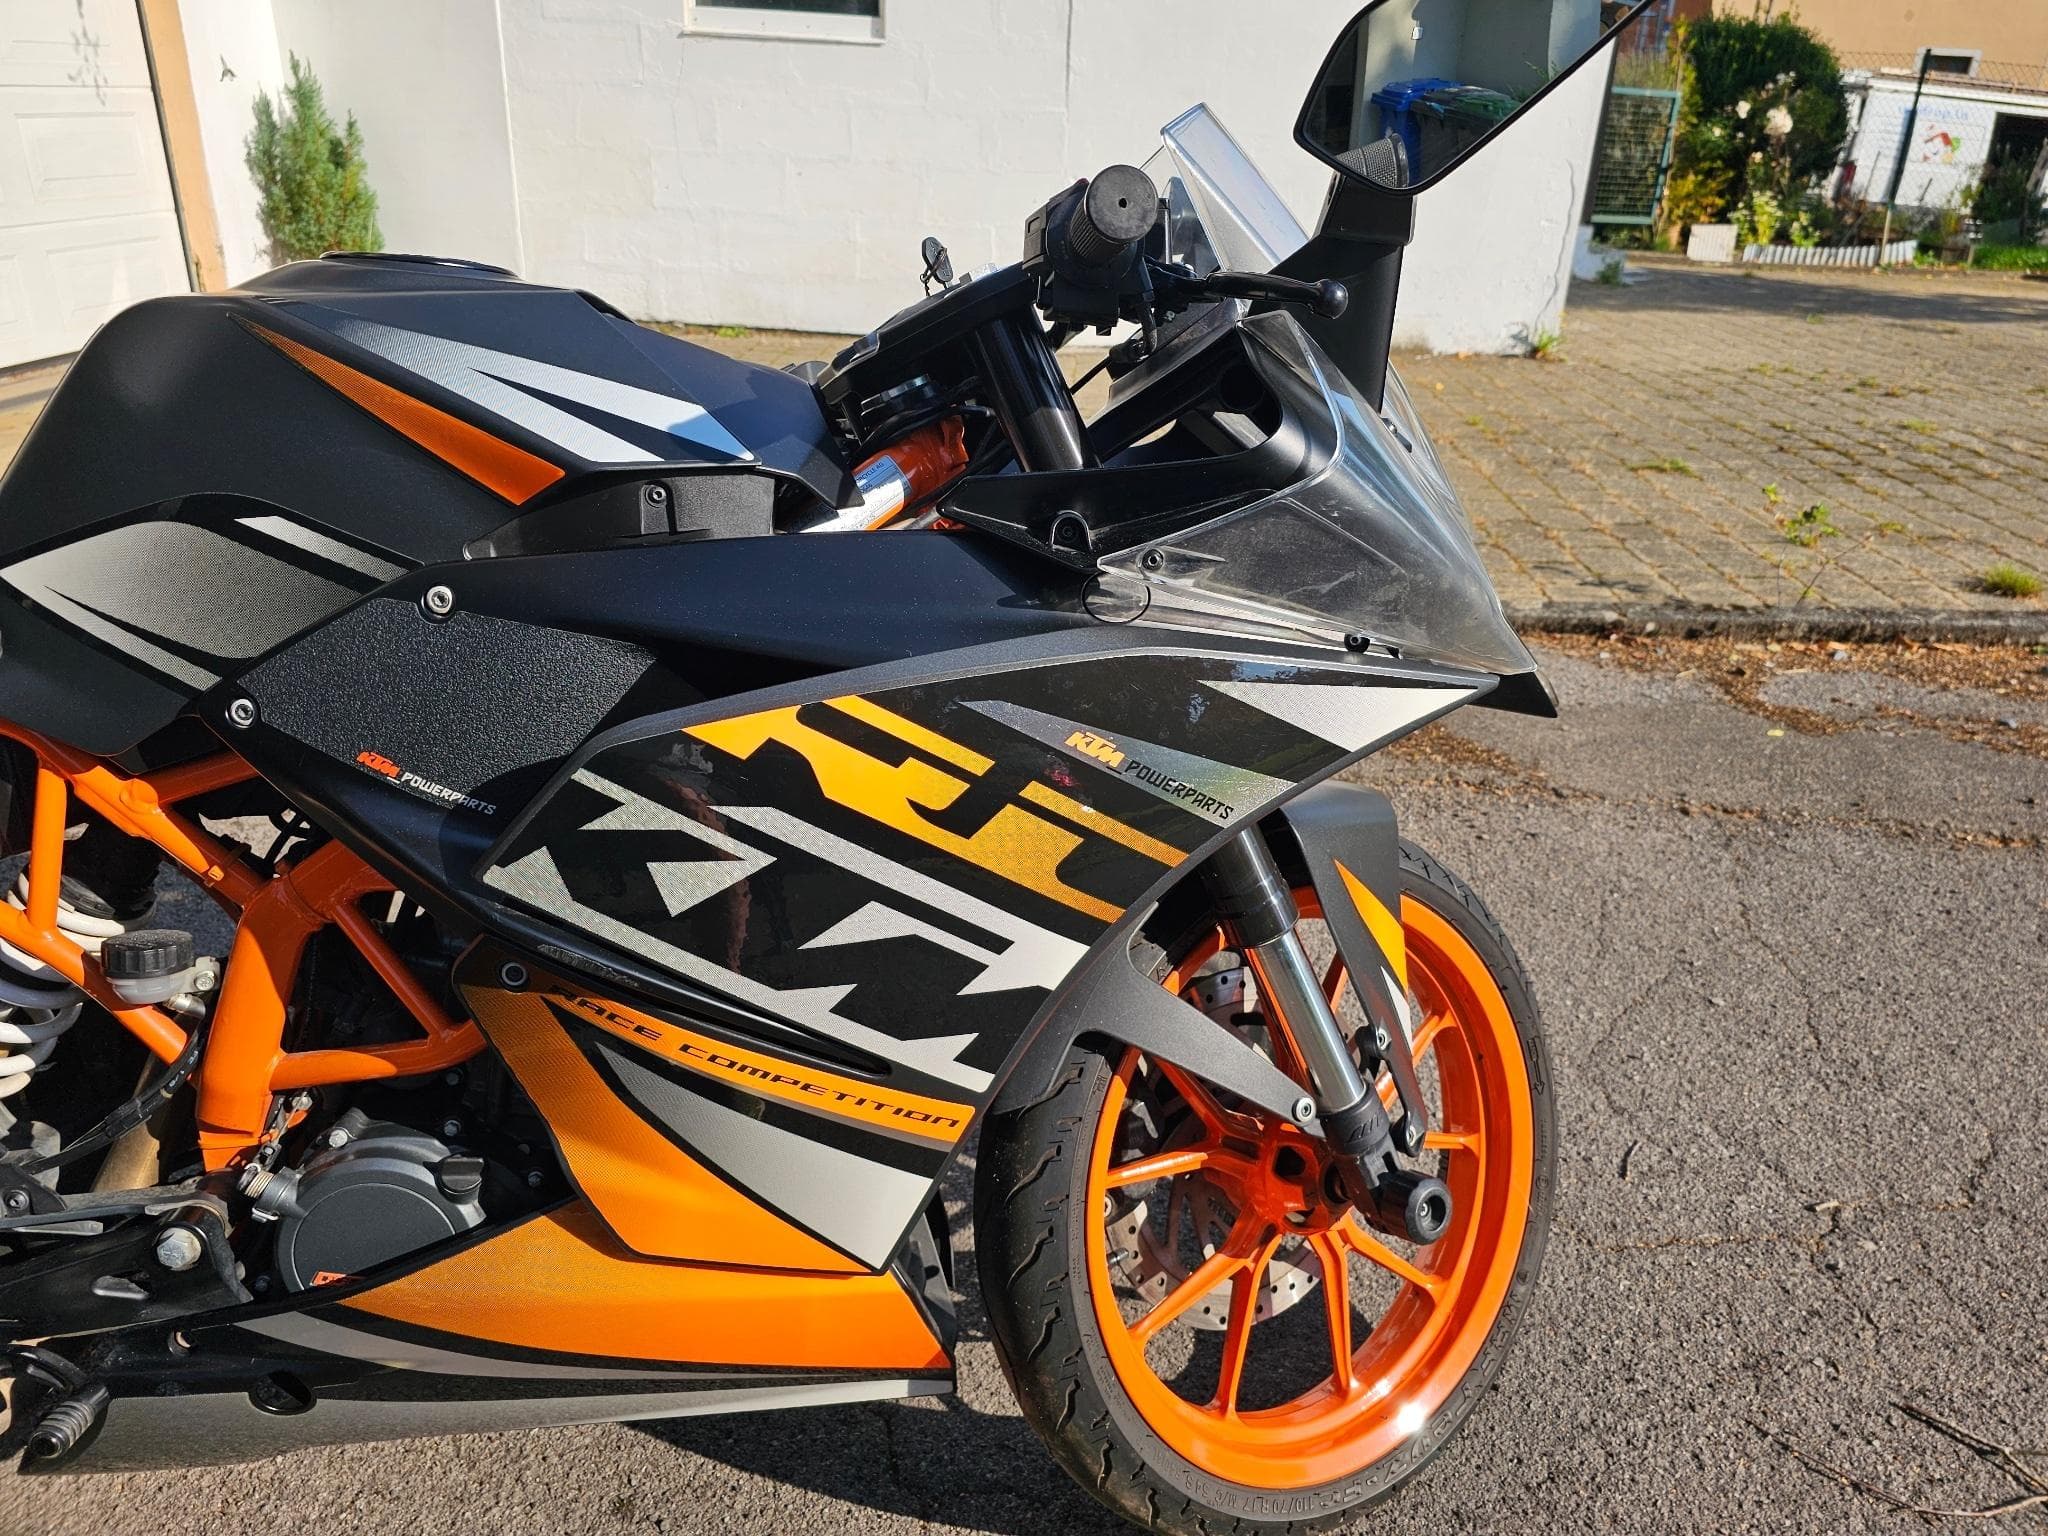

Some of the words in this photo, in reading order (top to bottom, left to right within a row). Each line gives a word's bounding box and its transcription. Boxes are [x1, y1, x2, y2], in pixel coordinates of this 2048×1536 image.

[356, 751, 401, 779] KTM
[401, 771, 497, 816] POWERPARTS
[1064, 731, 1126, 768] KTM
[1125, 760, 1235, 820] POWERPARTS
[483, 769, 1089, 1092] KTM
[549, 984, 663, 1041] RACE
[678, 1043, 961, 1128] COMPETITION
[1271, 1498, 1315, 1514] 110/70
